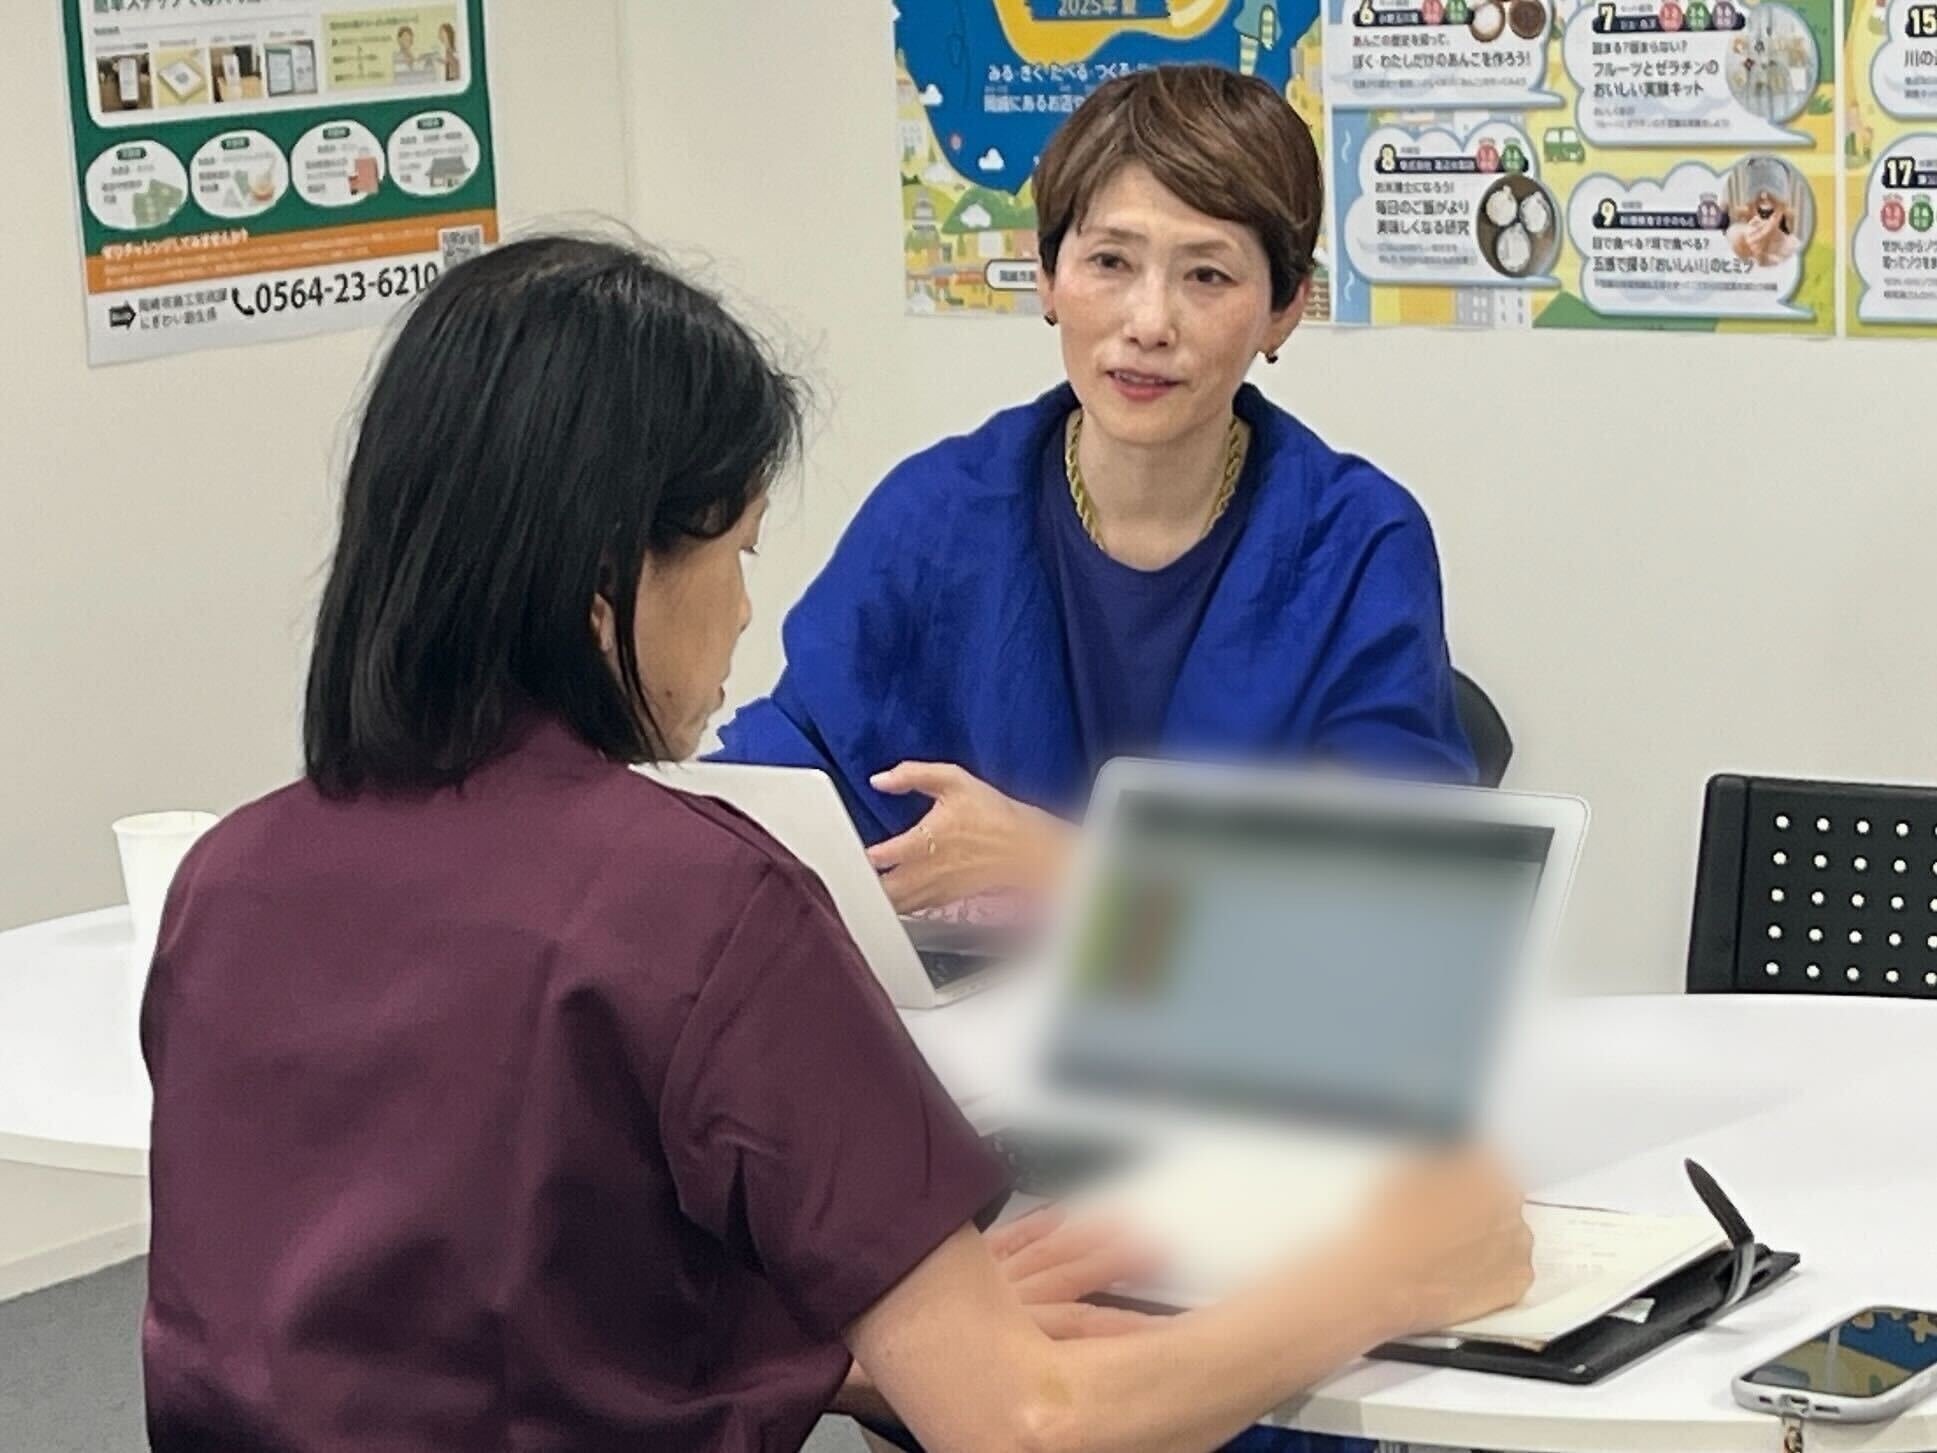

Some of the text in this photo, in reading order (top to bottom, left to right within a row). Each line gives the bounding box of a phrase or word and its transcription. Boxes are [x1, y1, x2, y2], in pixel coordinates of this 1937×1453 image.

[1359, 0, 1375, 24] 6
[1601, 5, 1614, 31] 7
[1910, 8, 1937, 36] 15
[1593, 60, 1719, 77] フルーツとゼラチンの
[1904, 50, 1937, 67] 川の
[1593, 81, 1704, 98] おいしい実験キット
[1381, 146, 1396, 171] 8
[1887, 159, 1912, 187] 17
[1376, 199, 1469, 215] 毎日のご飯がより
[1601, 201, 1615, 227] 9
[1377, 219, 1470, 236] 美味しくなる研究
[255, 261, 439, 313] 0564-23-6210
